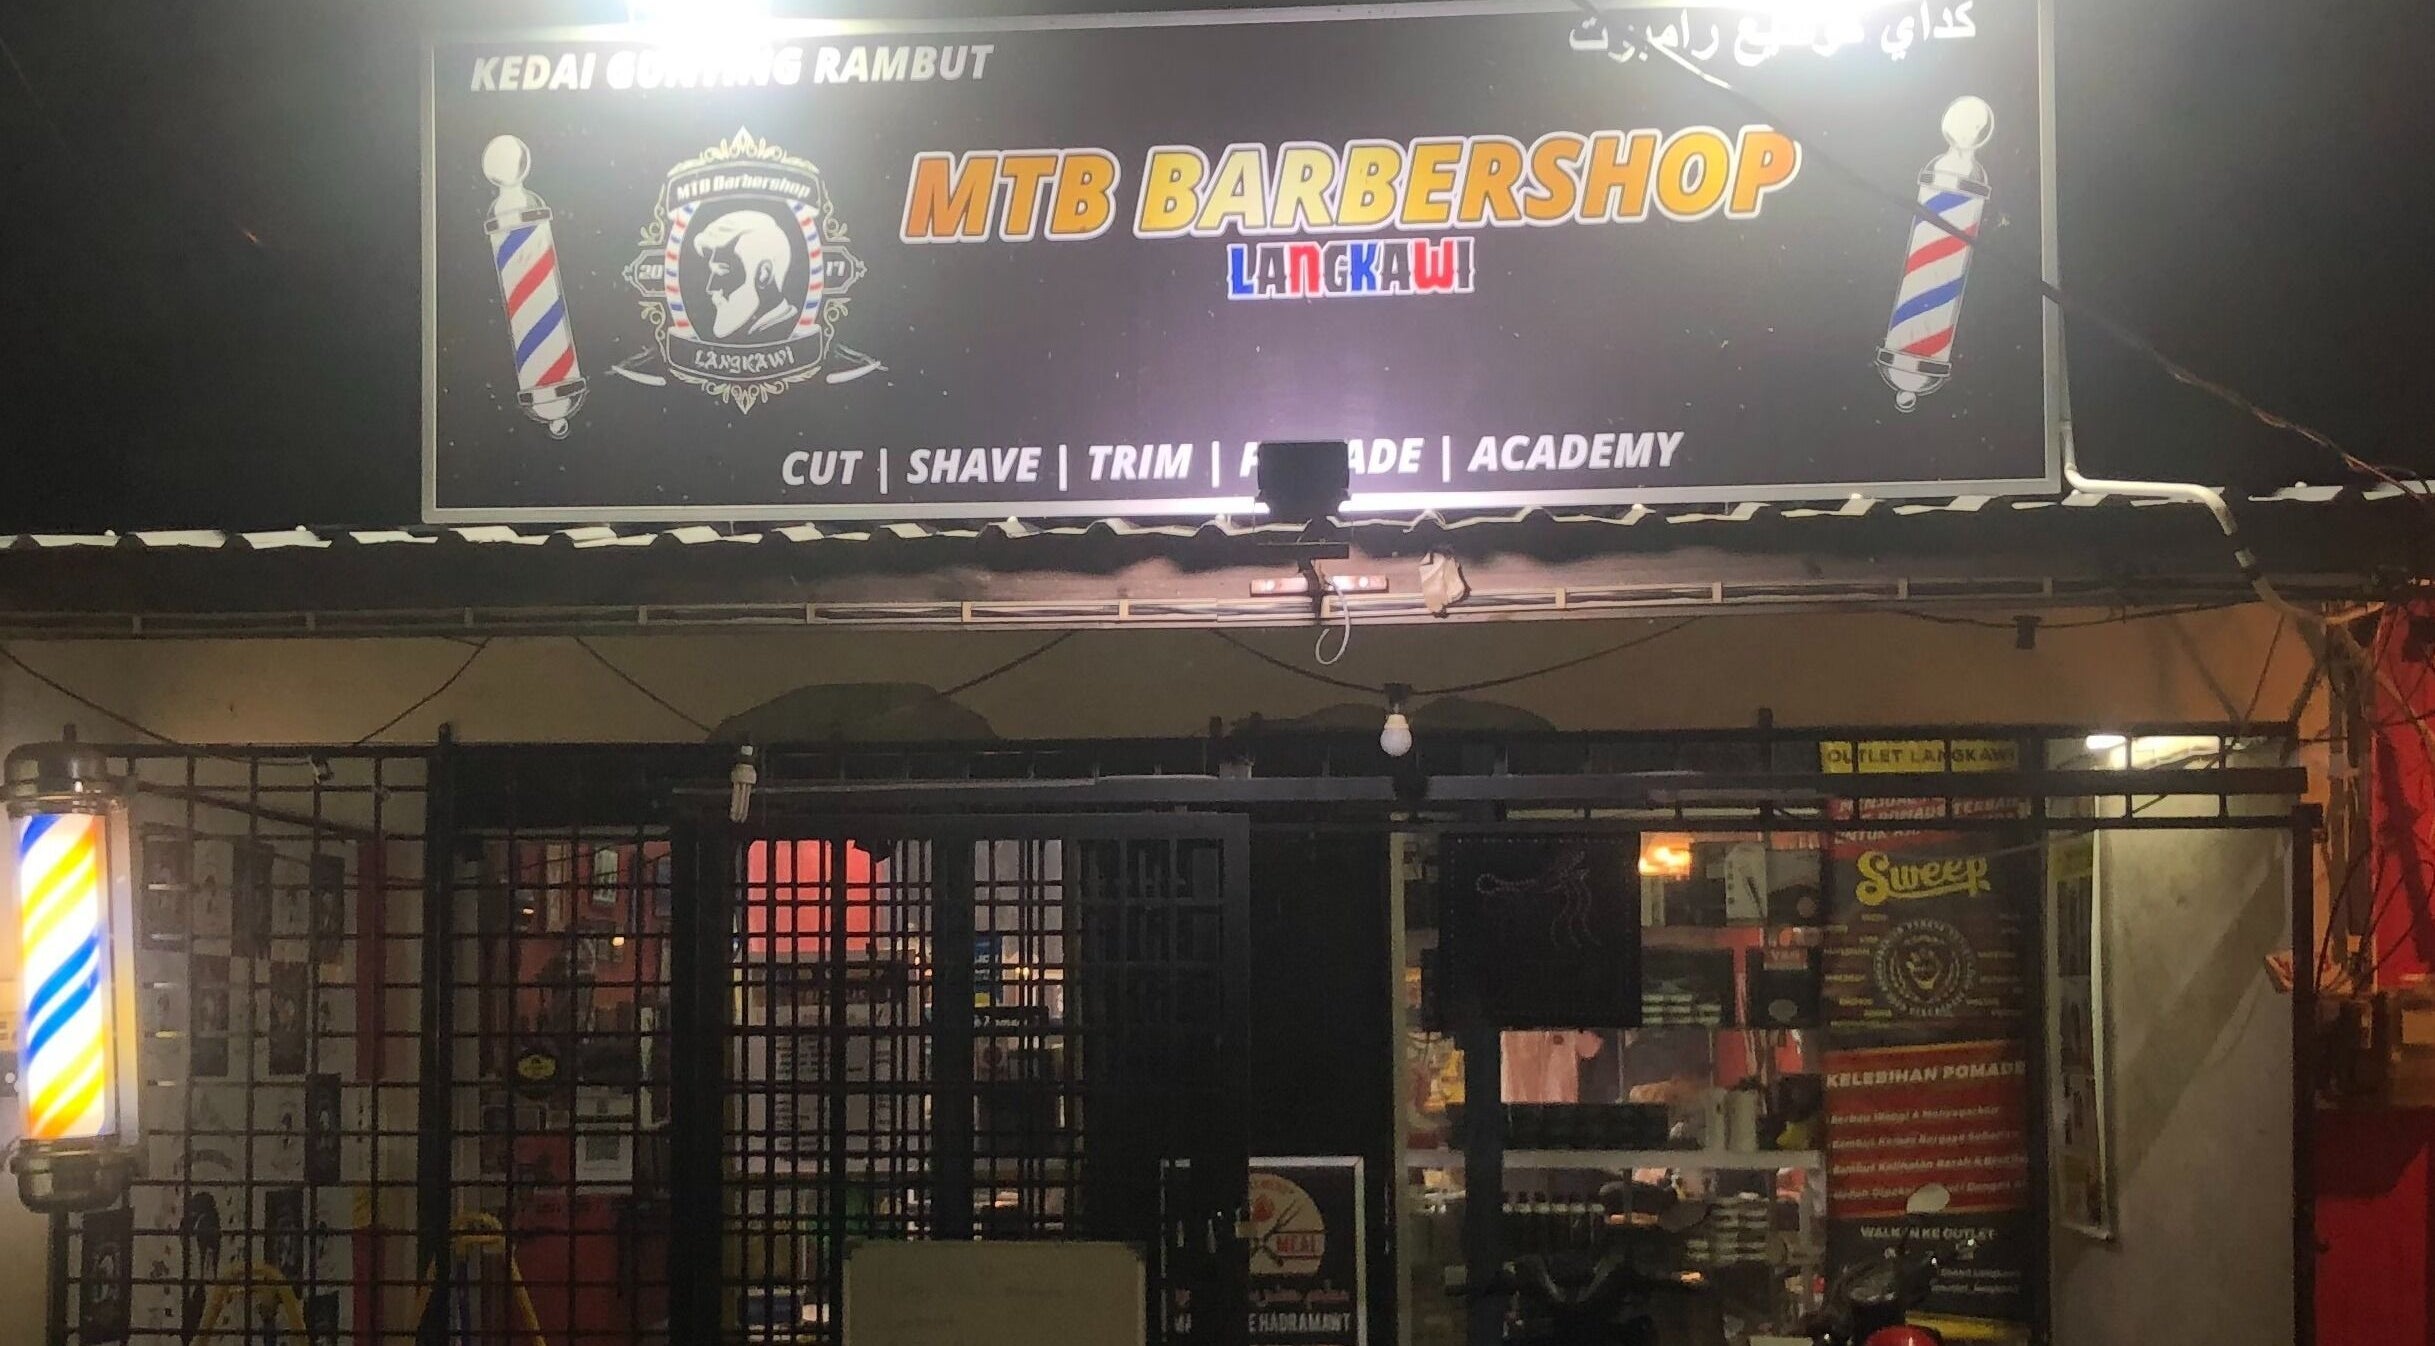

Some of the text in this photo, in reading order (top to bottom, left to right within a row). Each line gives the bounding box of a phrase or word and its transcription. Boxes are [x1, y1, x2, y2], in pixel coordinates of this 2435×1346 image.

[471, 45, 994, 92] KEDAI GUNG RAMBUT
[677, 174, 811, 201] MTB Barbershop
[900, 125, 1803, 244] MTB BARBERSHOP
[638, 264, 664, 280] 20
[825, 260, 845, 277] 17
[1227, 237, 1475, 300] LANGKAWI
[781, 431, 1685, 487] CUT SHAVE TRIM PADE ACADEMY
[1827, 748, 1904, 765] OUTLET
[1856, 850, 1991, 905] Sweep
[1826, 1060, 2026, 1088] KELEBIHAN POMADE
